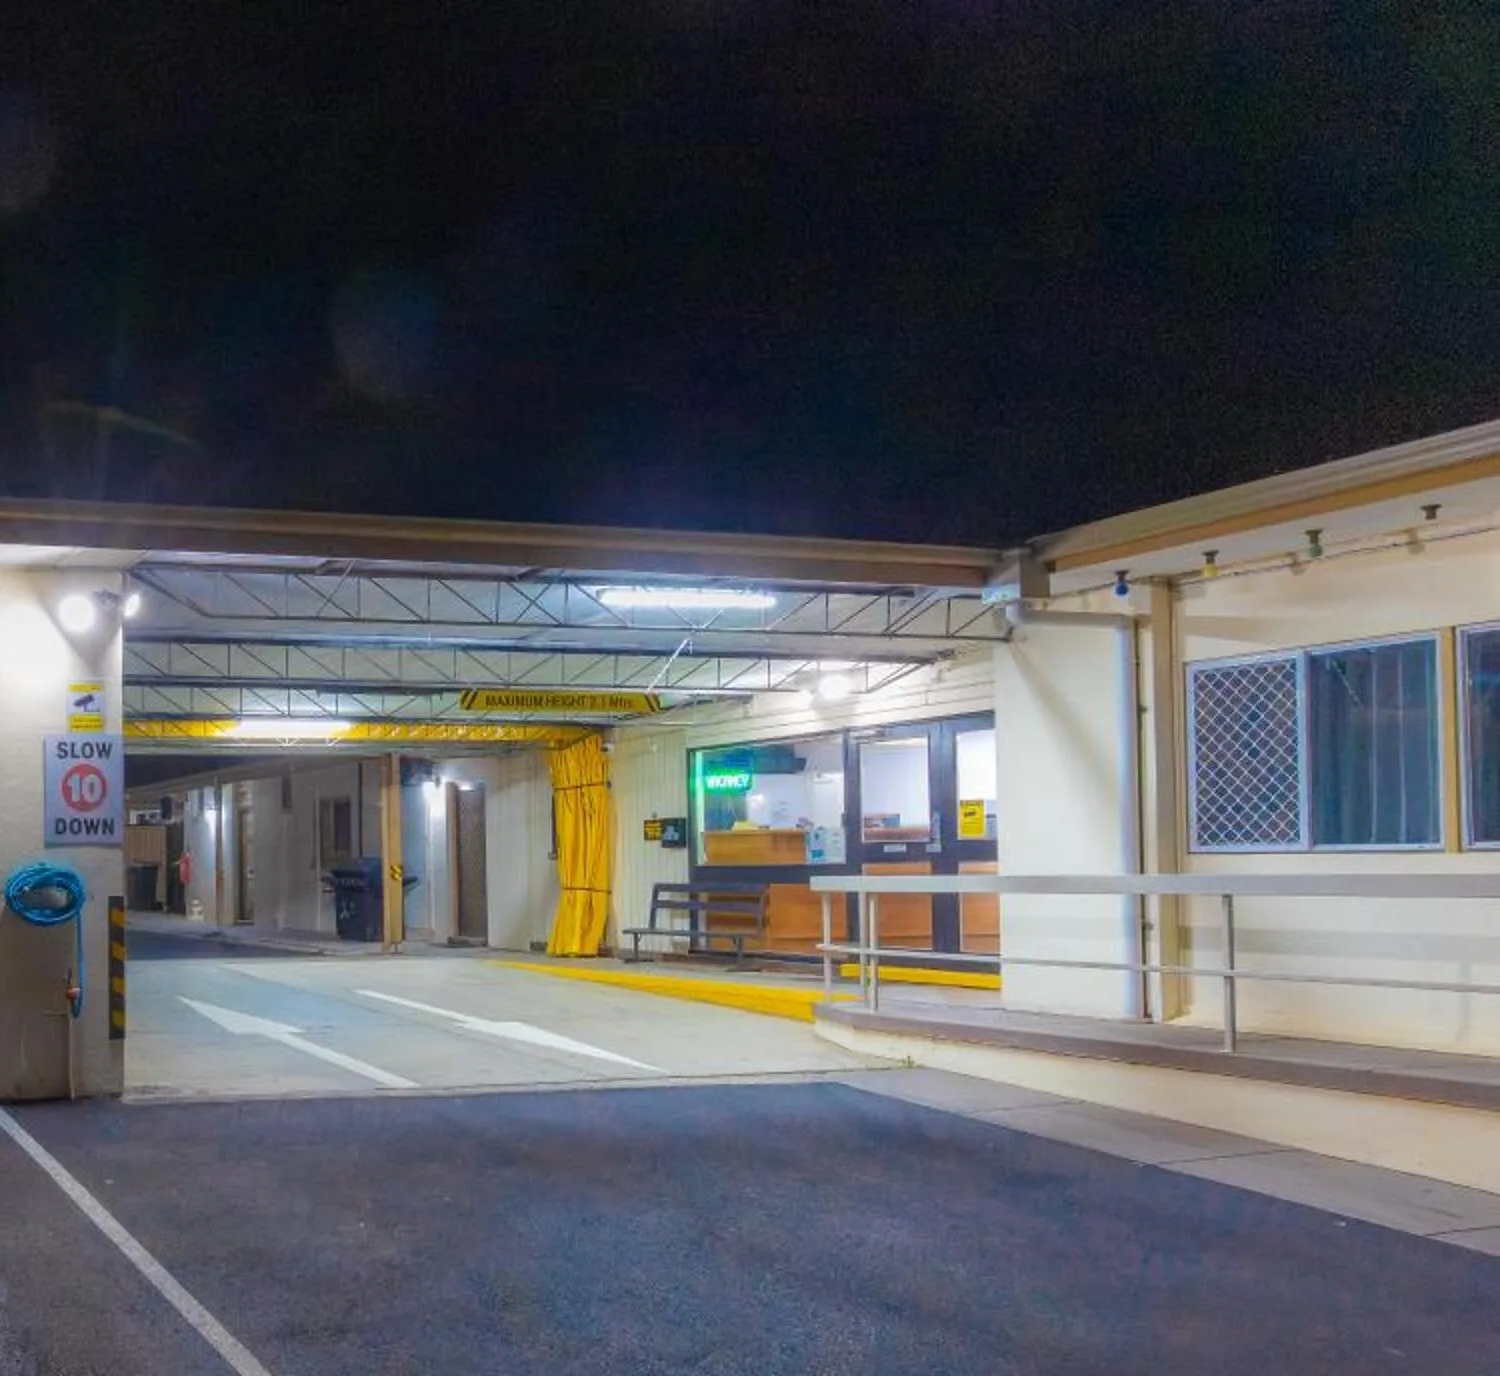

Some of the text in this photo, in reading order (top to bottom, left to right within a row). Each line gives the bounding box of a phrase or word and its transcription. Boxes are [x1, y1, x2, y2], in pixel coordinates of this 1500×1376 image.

[485, 694, 543, 708] MAXIMUM
[545, 694, 586, 707] HEIGHT
[56, 742, 113, 760] SLOW
[68, 773, 101, 804] 10
[54, 817, 115, 836] DOWN
